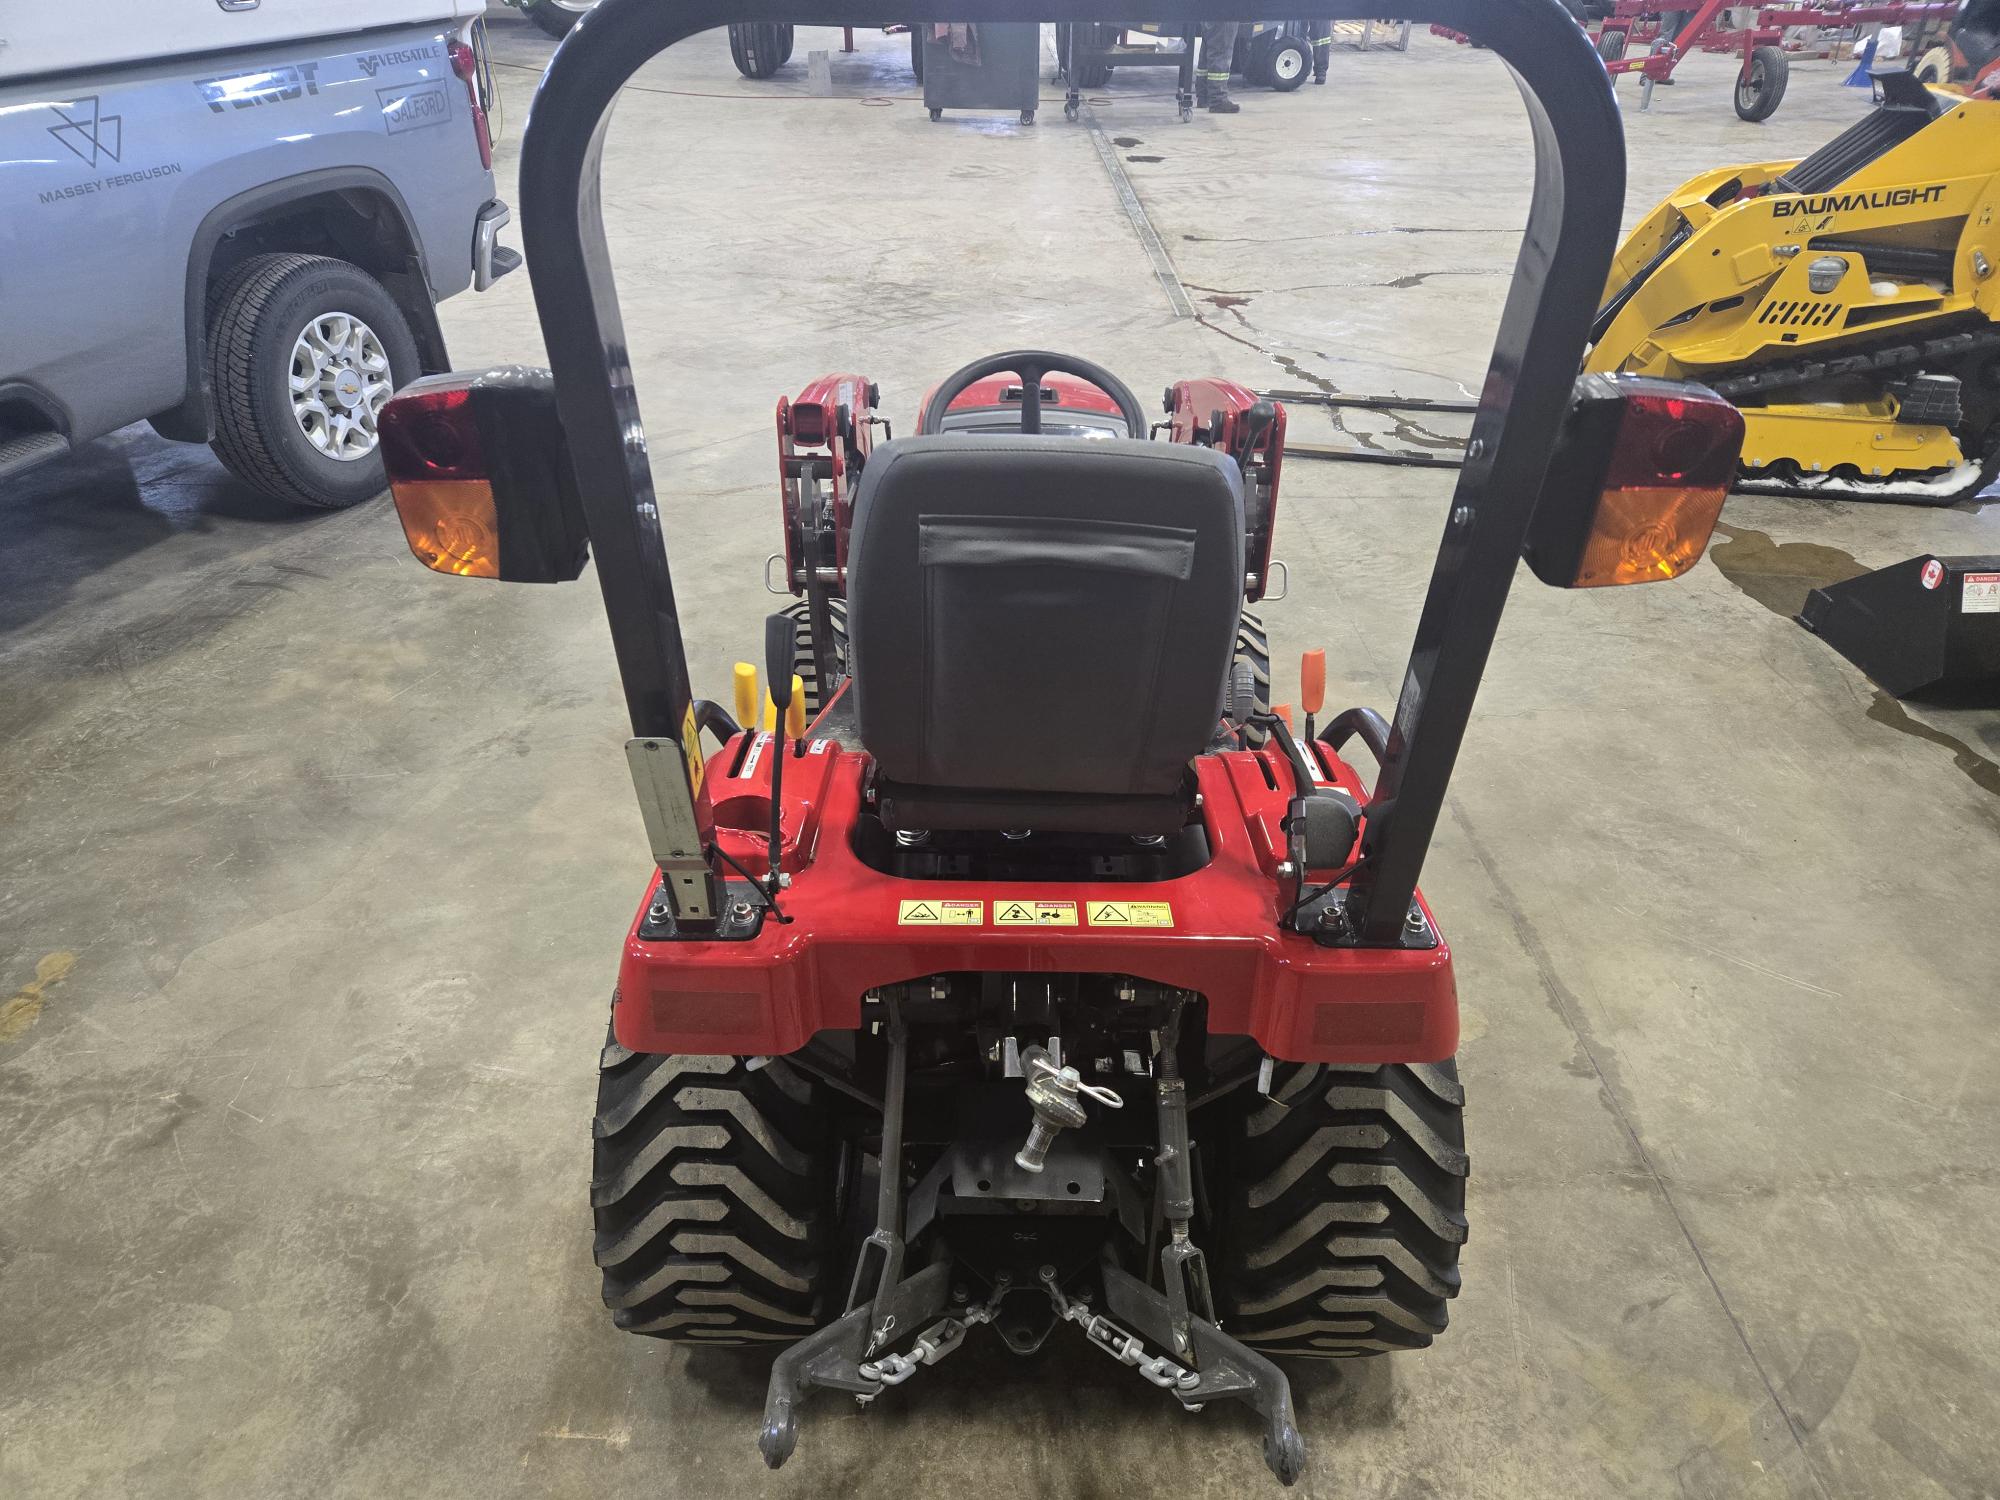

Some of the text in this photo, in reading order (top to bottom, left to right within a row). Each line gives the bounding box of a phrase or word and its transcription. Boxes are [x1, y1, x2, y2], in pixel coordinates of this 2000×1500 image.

[377, 45, 441, 67] VERSATILE
[386, 90, 446, 123] SALFORD
[38, 162, 182, 204] MASSEY FERGUSON
[1772, 185, 1947, 217] BAUMALIGHT
